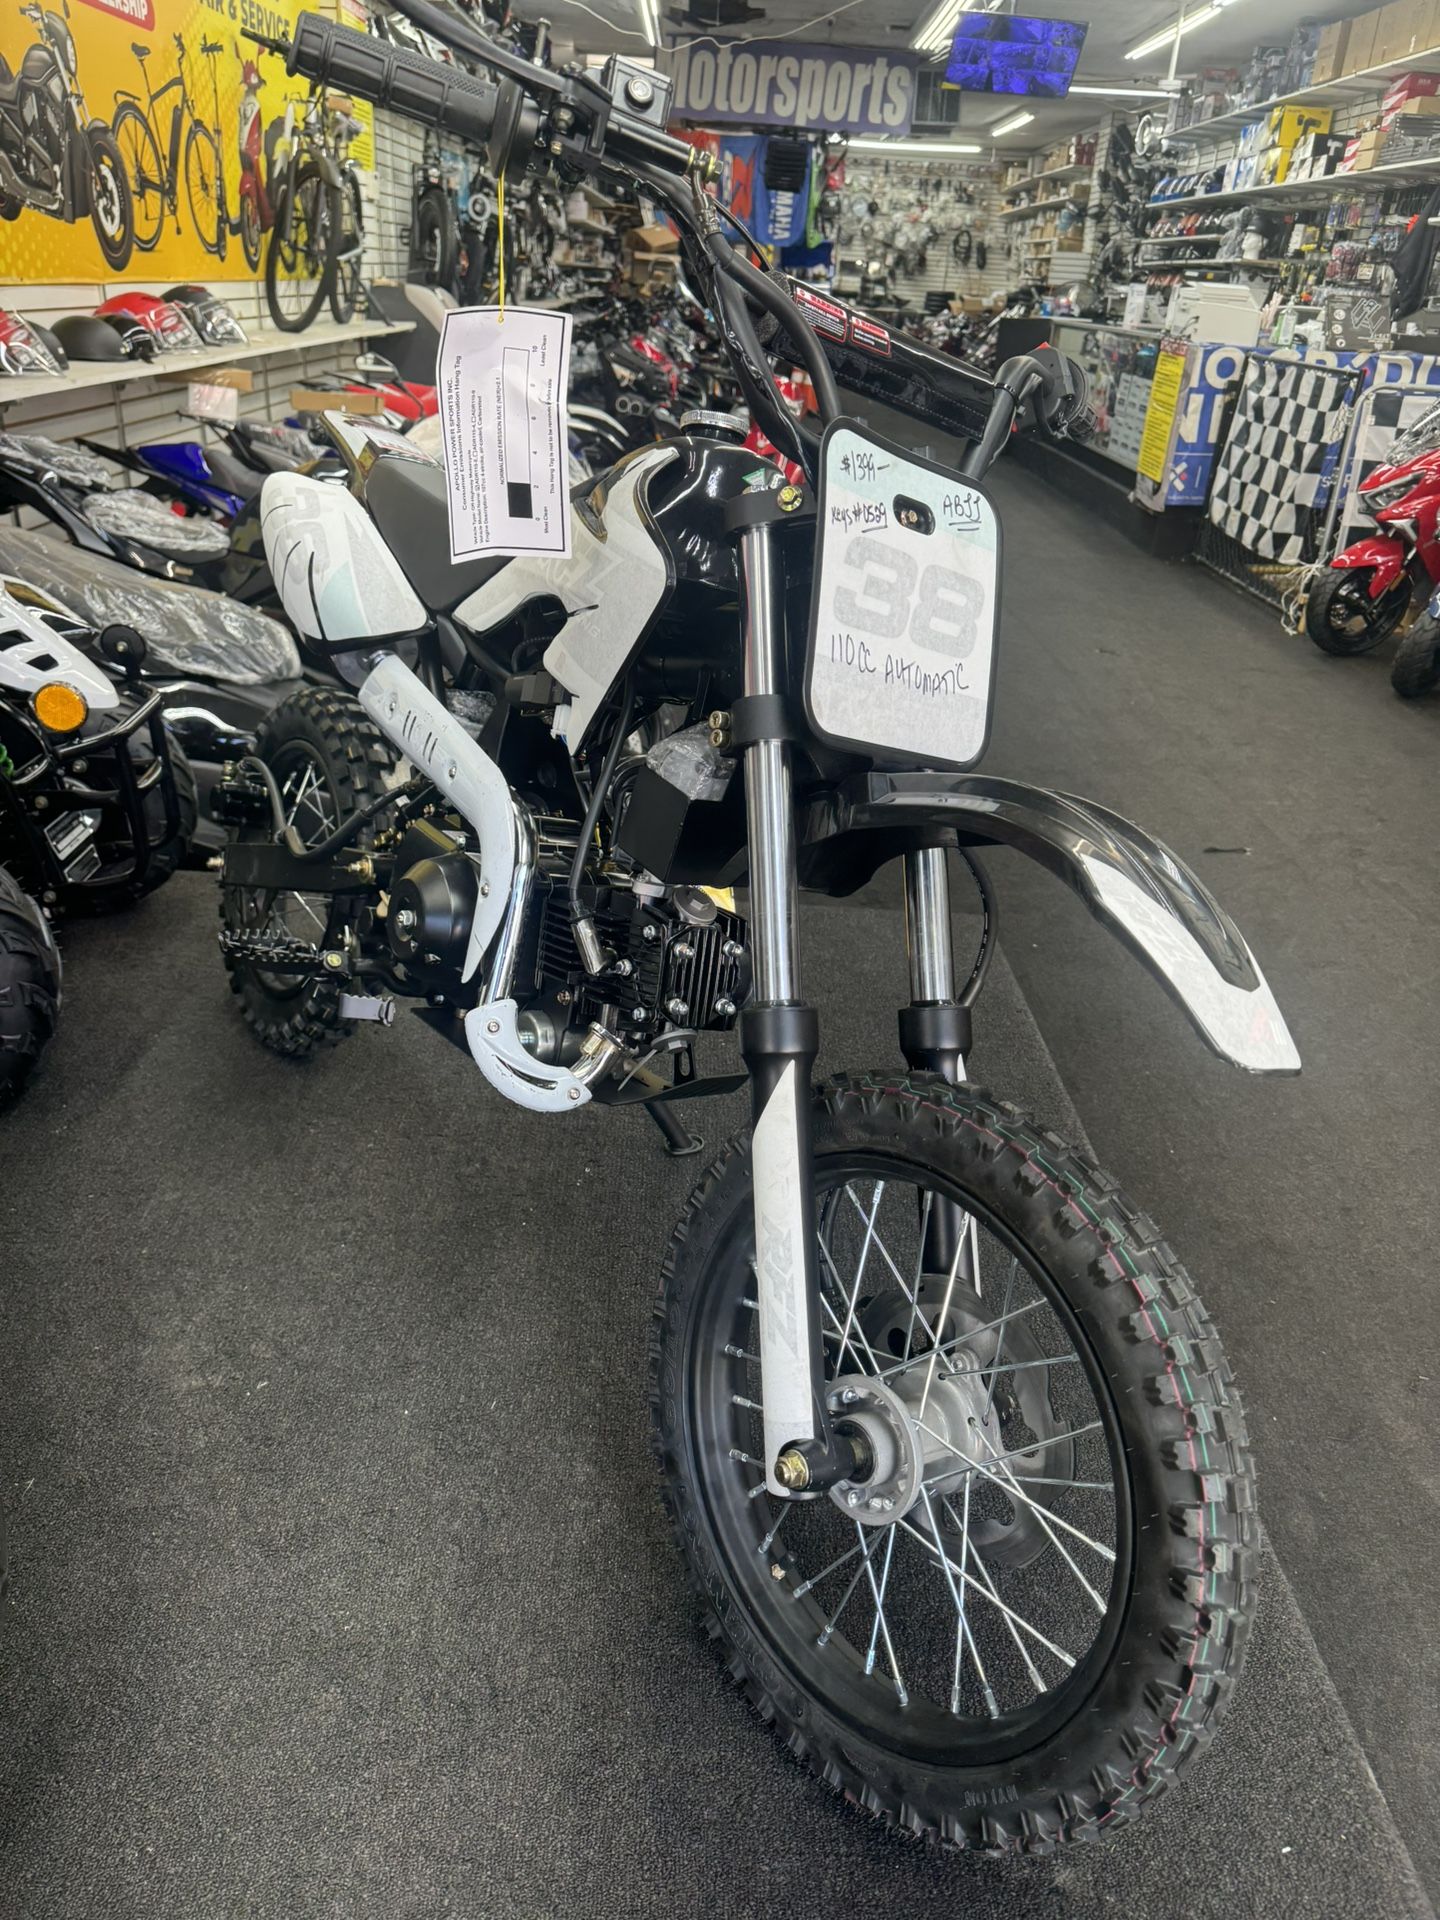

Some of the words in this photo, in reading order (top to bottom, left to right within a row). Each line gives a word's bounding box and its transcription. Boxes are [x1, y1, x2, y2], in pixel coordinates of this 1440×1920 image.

[240, 0, 290, 39] SERVICE
[656, 36, 912, 126] Motorsports
[833, 536, 985, 659] 38
